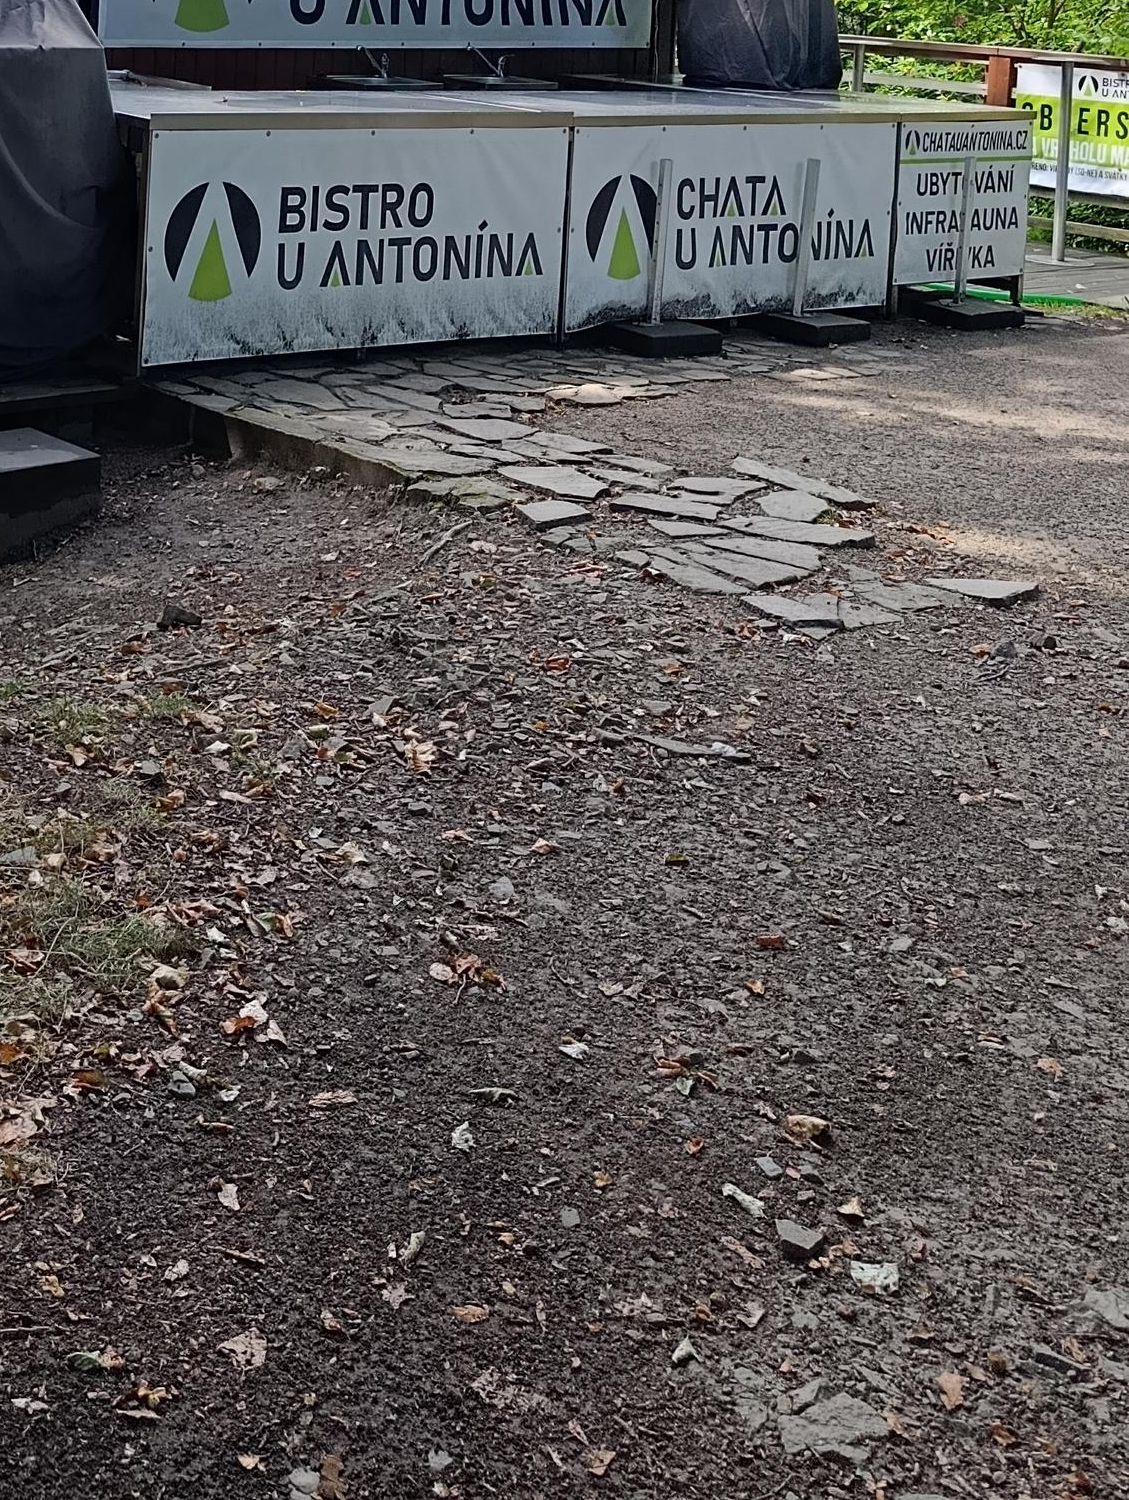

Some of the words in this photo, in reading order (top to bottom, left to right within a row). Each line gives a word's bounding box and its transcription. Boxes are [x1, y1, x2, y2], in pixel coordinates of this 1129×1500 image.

[1102, 88, 1109, 97] U
[922, 130, 1028, 153] CHATAUANTONINA.CZ
[676, 175, 787, 221] CHATA
[916, 164, 1015, 196] UBYTVÁNÍ
[278, 182, 435, 234] BISTRO
[905, 206, 1019, 236] INFRAAUNA
[277, 242, 305, 291] U
[319, 218, 544, 288] ANTONÍNA
[675, 227, 697, 270] U
